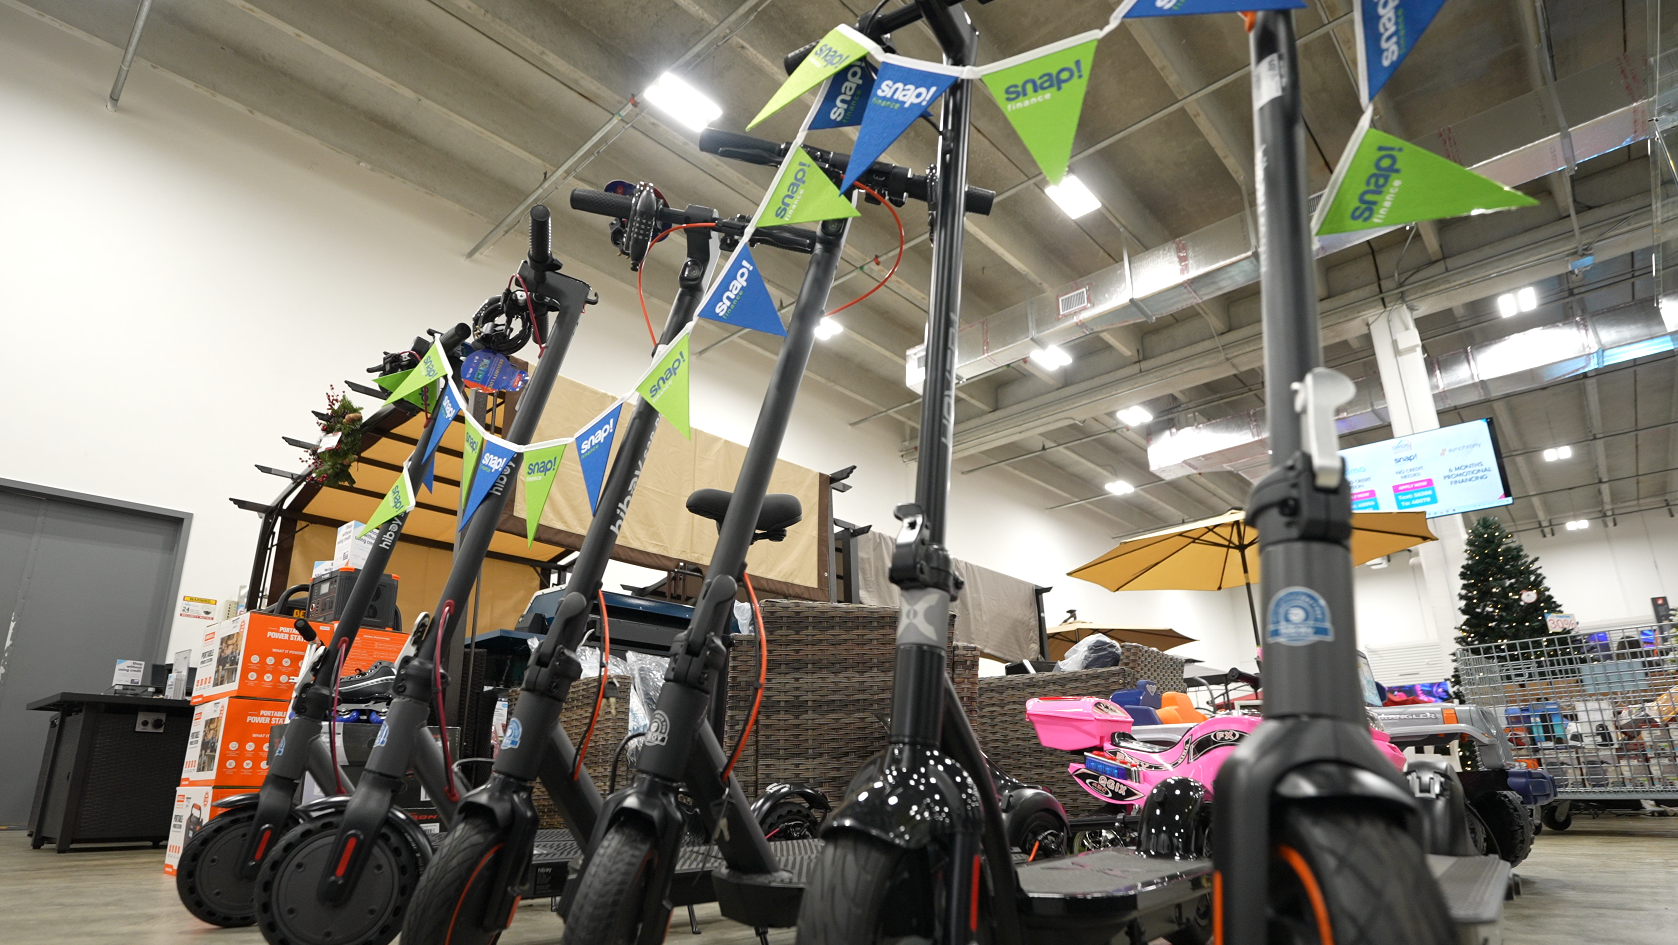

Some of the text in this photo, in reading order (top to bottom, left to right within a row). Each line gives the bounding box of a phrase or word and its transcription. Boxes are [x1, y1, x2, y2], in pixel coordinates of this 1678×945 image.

[814, 43, 850, 69] snap!
[1004, 58, 1084, 102] snap!
[842, 89, 862, 123] finance
[871, 97, 901, 109] finance
[876, 79, 938, 108] snap!
[1006, 92, 1052, 112] finance
[775, 161, 811, 220] snap!
[1350, 145, 1404, 223] snap!
[784, 188, 805, 222] finance
[1372, 179, 1402, 223] finance
[714, 259, 754, 317] snap!
[722, 290, 744, 320] finance
[424, 355, 440, 381] snap!
[649, 351, 686, 398] snap!
[652, 380, 674, 404] finance
[442, 395, 456, 421] snap!
[465, 431, 479, 454] snap!
[580, 418, 614, 454] snap!
[481, 453, 507, 473] snap!
[527, 456, 558, 477] snap!
[1394, 453, 1417, 465] snap!
[1455, 461, 1483, 471] MONTHS
[1443, 467, 1492, 480] PROMOTIONAL
[1450, 474, 1488, 486] FINANCING
[392, 485, 404, 513] snap!
[379, 516, 403, 550] hiboy
[267, 631, 288, 640] POWER
[1549, 618, 1577, 629] 30%
[247, 716, 270, 724] POWER
[1216, 731, 1233, 741] FX
